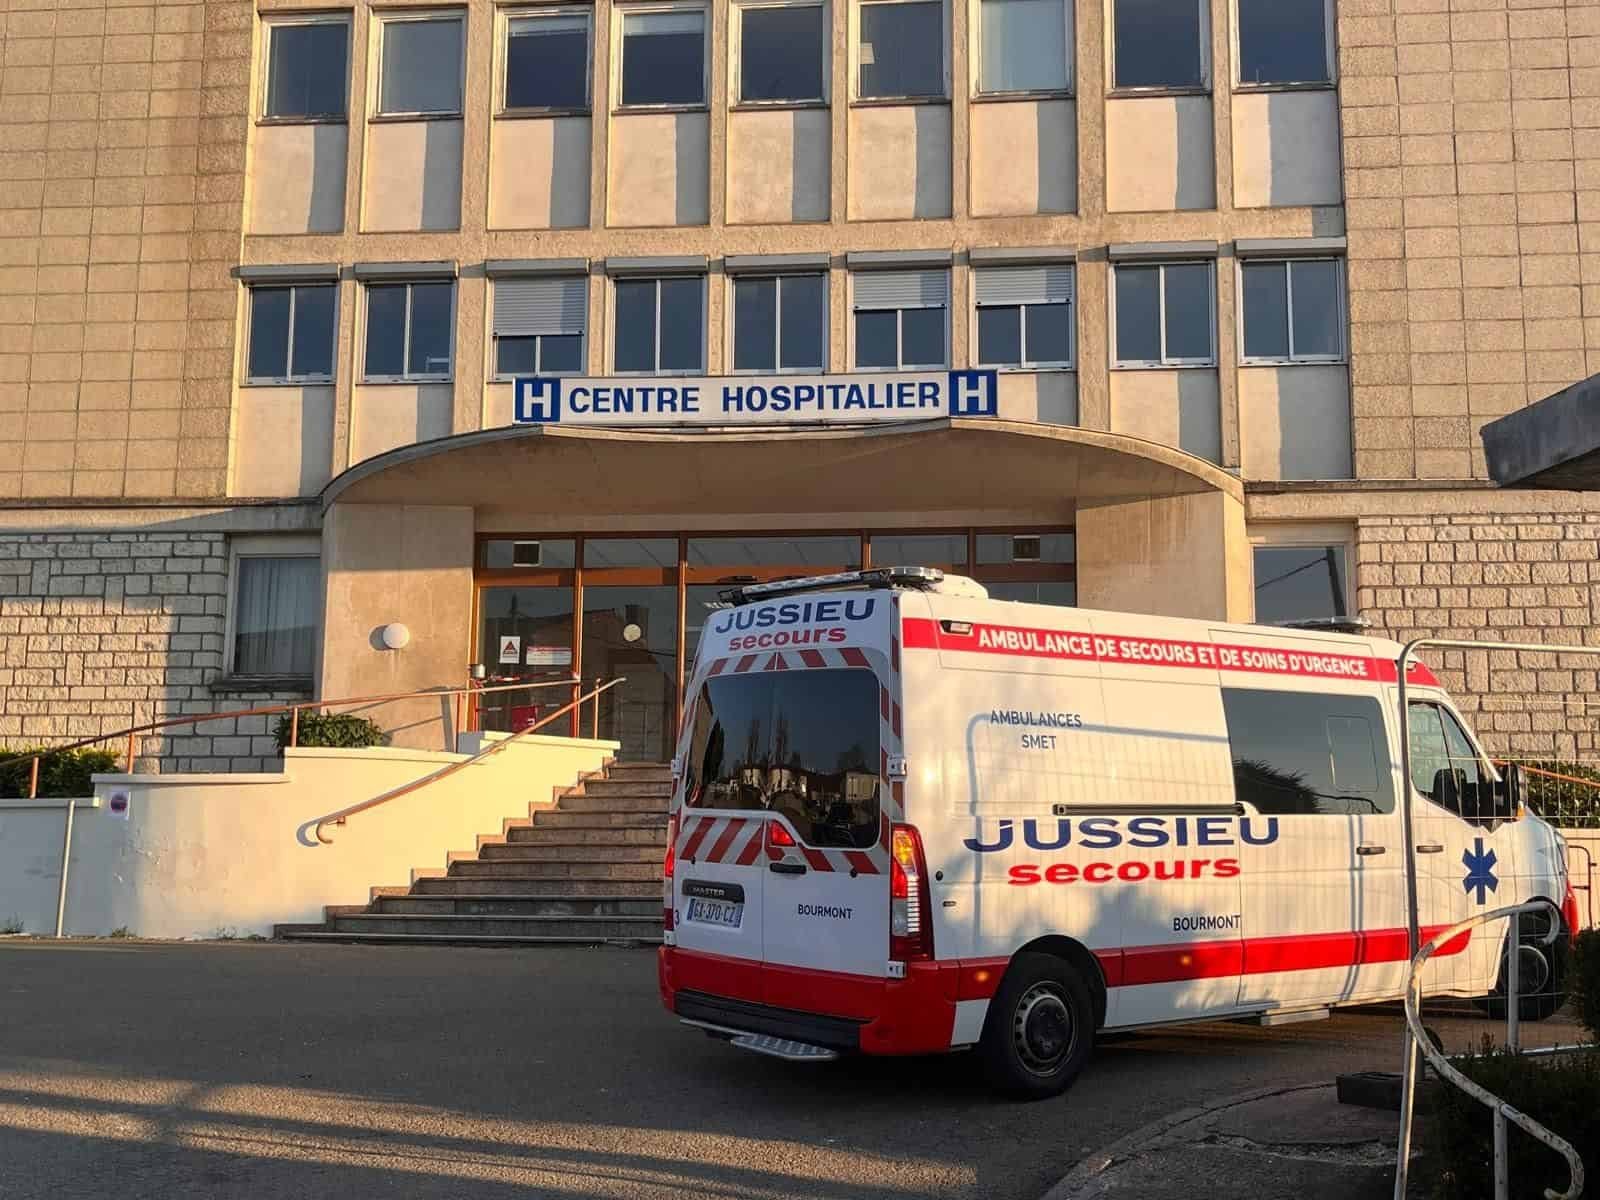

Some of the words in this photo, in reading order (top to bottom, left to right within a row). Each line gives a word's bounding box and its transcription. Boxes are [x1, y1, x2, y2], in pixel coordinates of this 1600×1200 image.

[523, 383, 551, 418] H
[568, 387, 700, 413] CENTRE
[722, 381, 941, 412] HOSPITALIER
[958, 376, 988, 412] H
[729, 628, 847, 651] secours
[978, 629, 1093, 655] AMBULANCE
[1094, 638, 1119, 657] DE
[1119, 641, 1195, 664] SECOURS
[1197, 647, 1218, 665] ET
[1219, 649, 1242, 667] DE
[1242, 651, 1287, 671] SOINS
[1288, 653, 1368, 677] D'URGENCE
[990, 710, 1082, 728] AMBULANCES
[1021, 734, 1057, 750] SMET
[1008, 858, 1241, 886] secours
[798, 904, 852, 919] BOURMONT
[1173, 914, 1241, 931] BOURMONT
